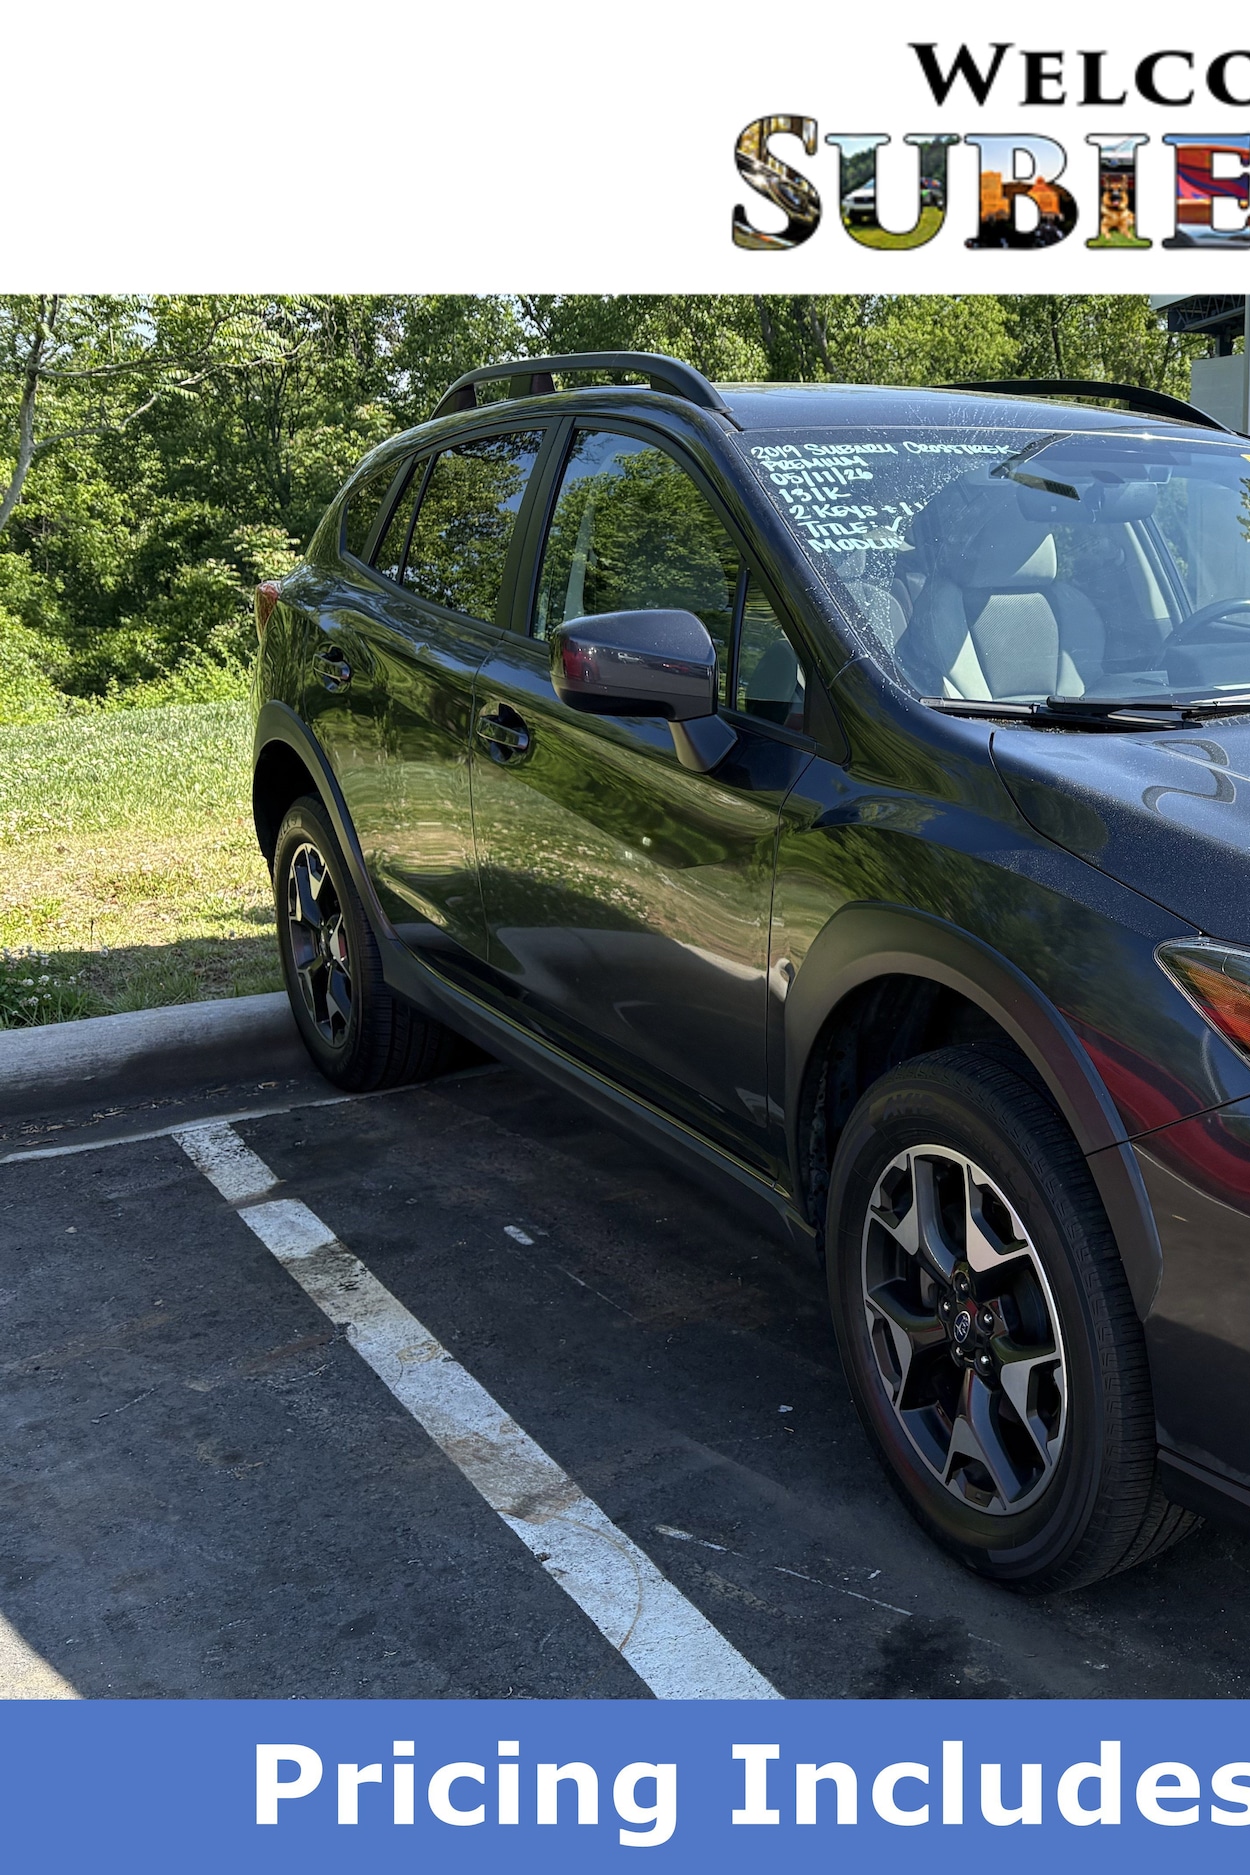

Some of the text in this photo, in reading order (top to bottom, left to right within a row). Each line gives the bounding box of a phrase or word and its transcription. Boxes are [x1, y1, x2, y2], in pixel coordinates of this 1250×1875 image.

[750, 445, 802, 460] 2019
[789, 504, 811, 519] 2
[812, 503, 878, 519] KEYS
